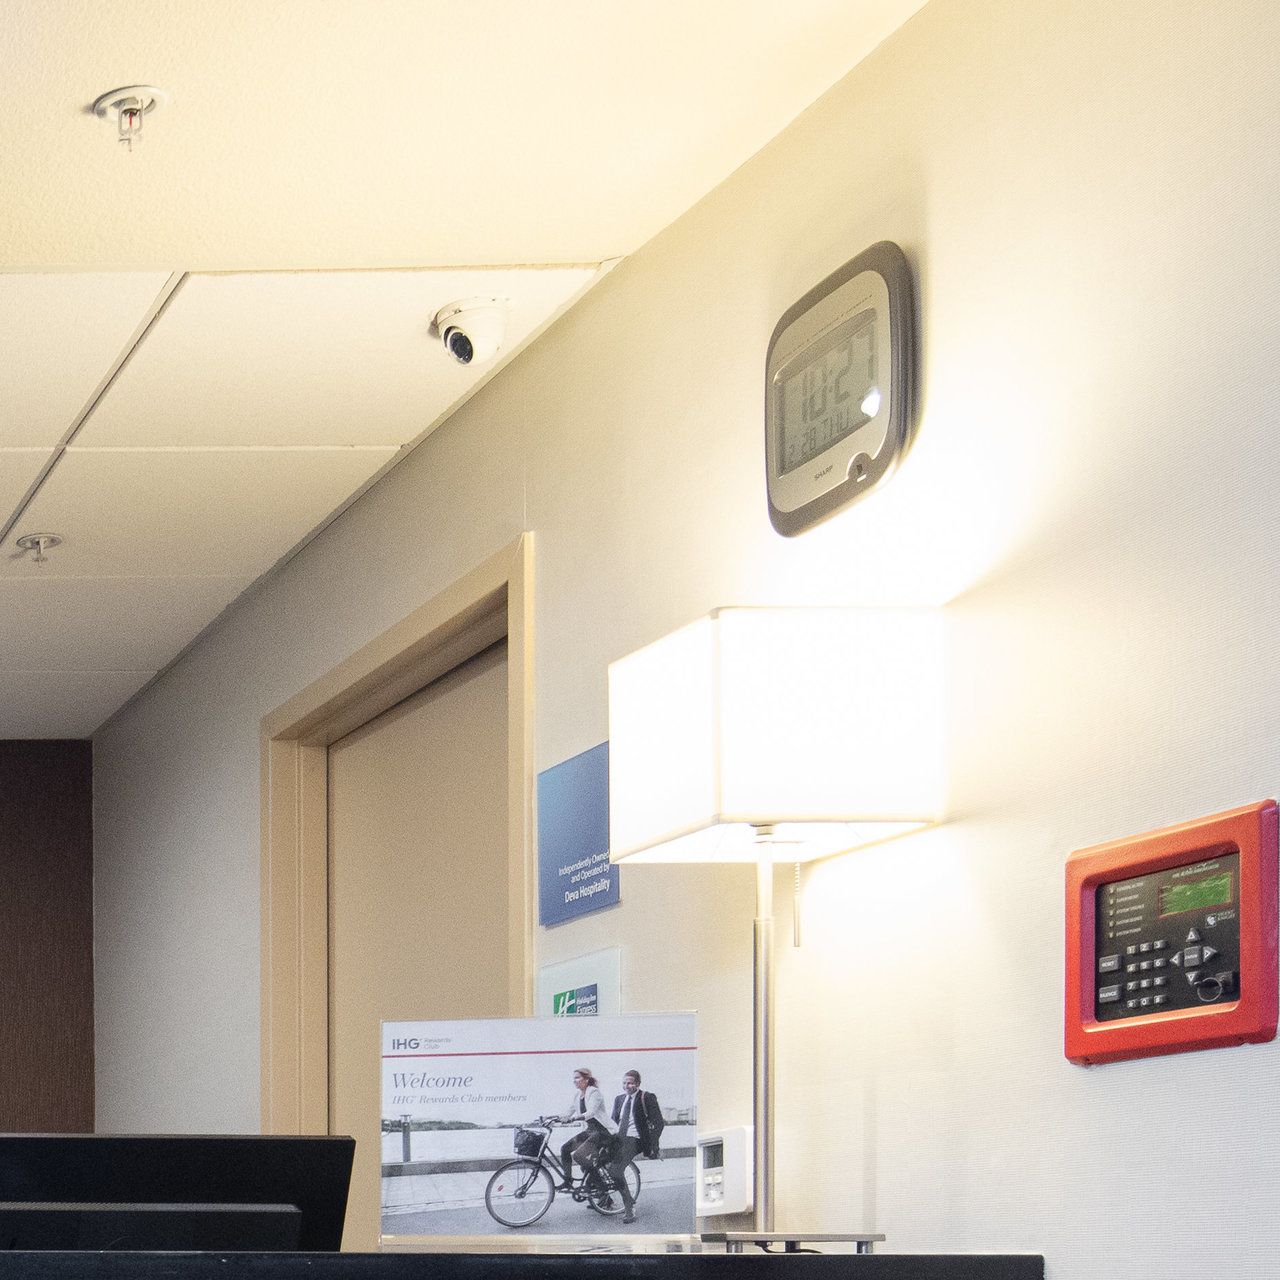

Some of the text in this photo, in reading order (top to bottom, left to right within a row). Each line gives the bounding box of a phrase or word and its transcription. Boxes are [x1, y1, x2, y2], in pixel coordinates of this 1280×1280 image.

[814, 465, 833, 480] SHARP
[559, 857, 591, 876] Independently
[571, 872, 580, 883] and
[581, 863, 603, 880] Operated
[580, 878, 611, 898] Hospitality
[392, 1038, 420, 1050] IHG
[393, 1072, 474, 1089] Welcome
[420, 1094, 459, 1104] Rewards
[460, 1093, 484, 1103] Club
[485, 1093, 527, 1102] members
